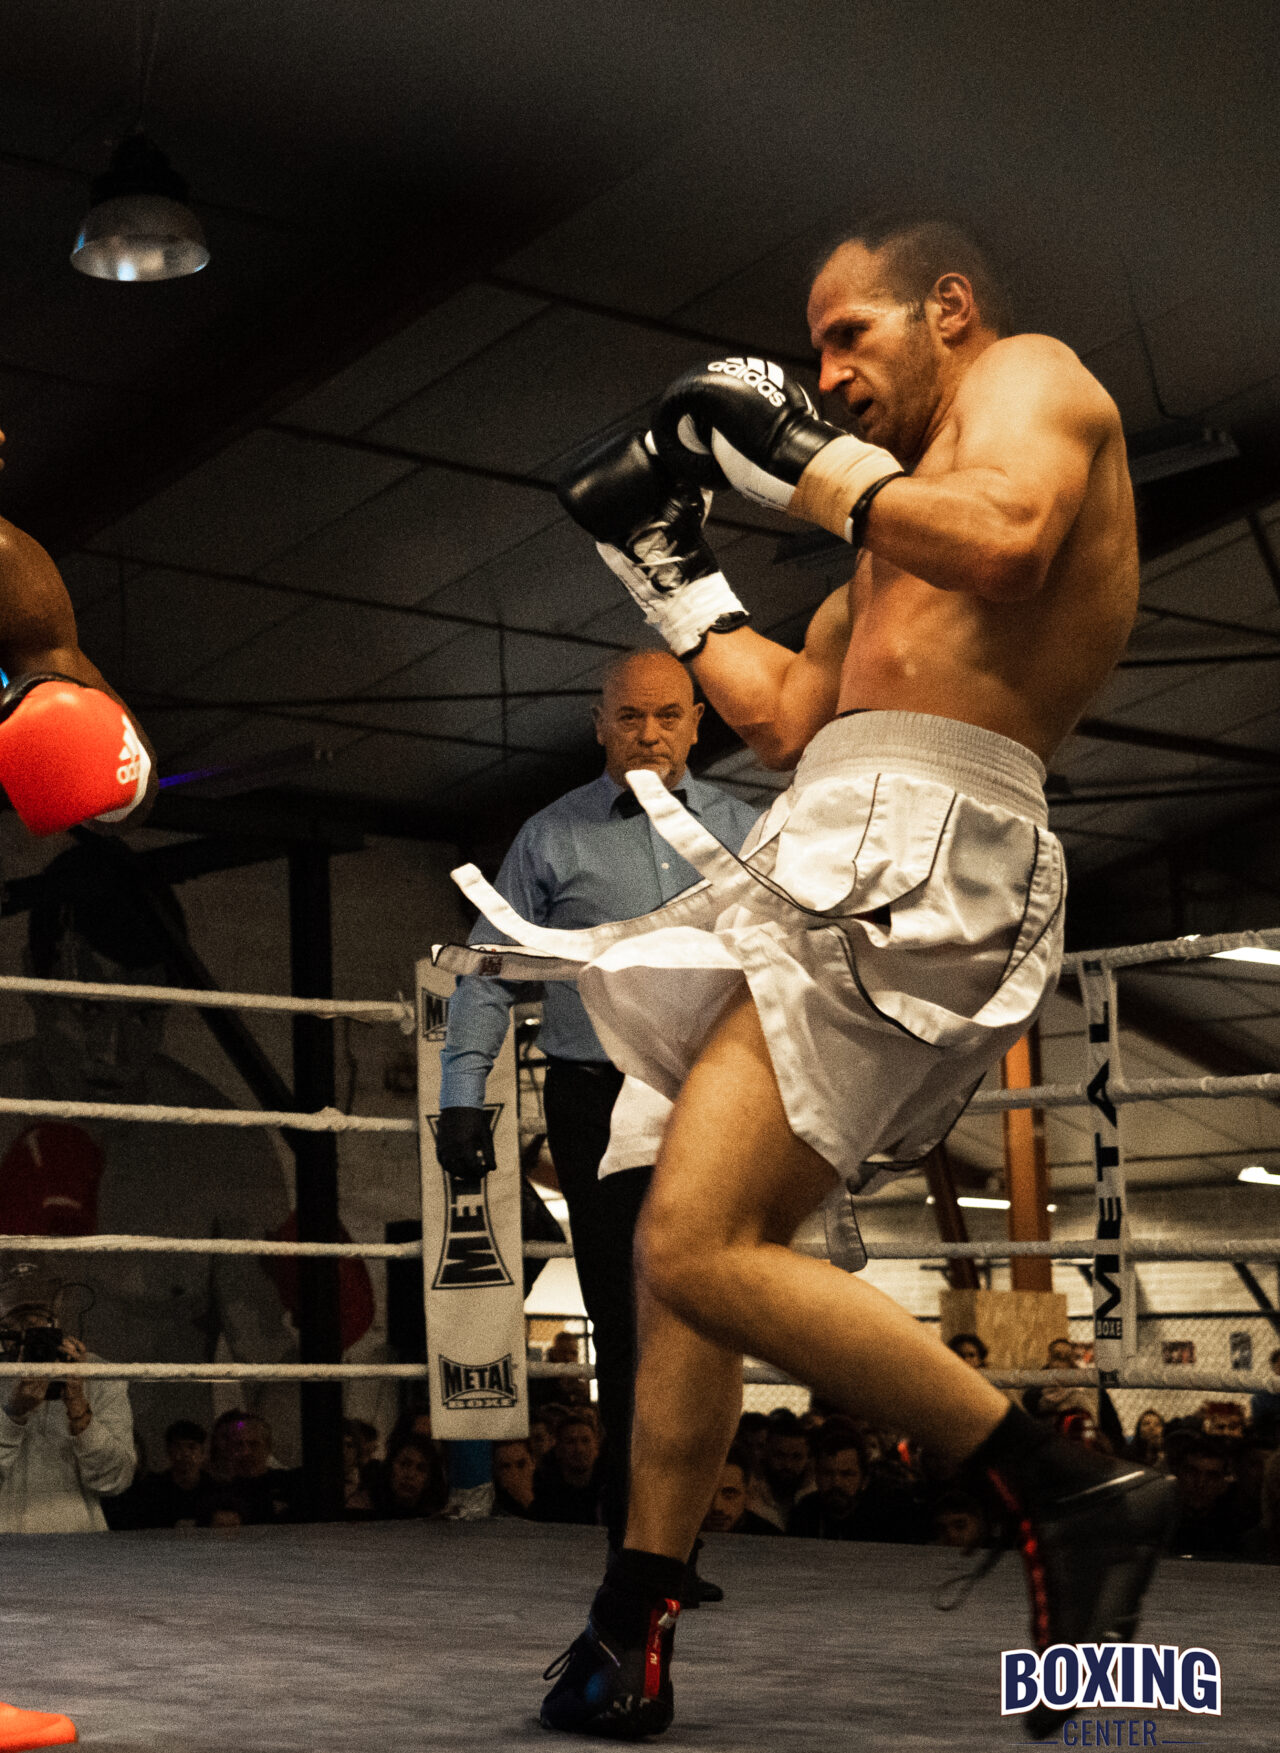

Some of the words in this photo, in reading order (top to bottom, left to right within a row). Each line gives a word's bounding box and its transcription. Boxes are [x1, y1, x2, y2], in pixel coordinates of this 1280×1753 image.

[707, 360, 786, 407] adidas
[1096, 1319, 1122, 1337] BOXE
[442, 1359, 516, 1401] METAL
